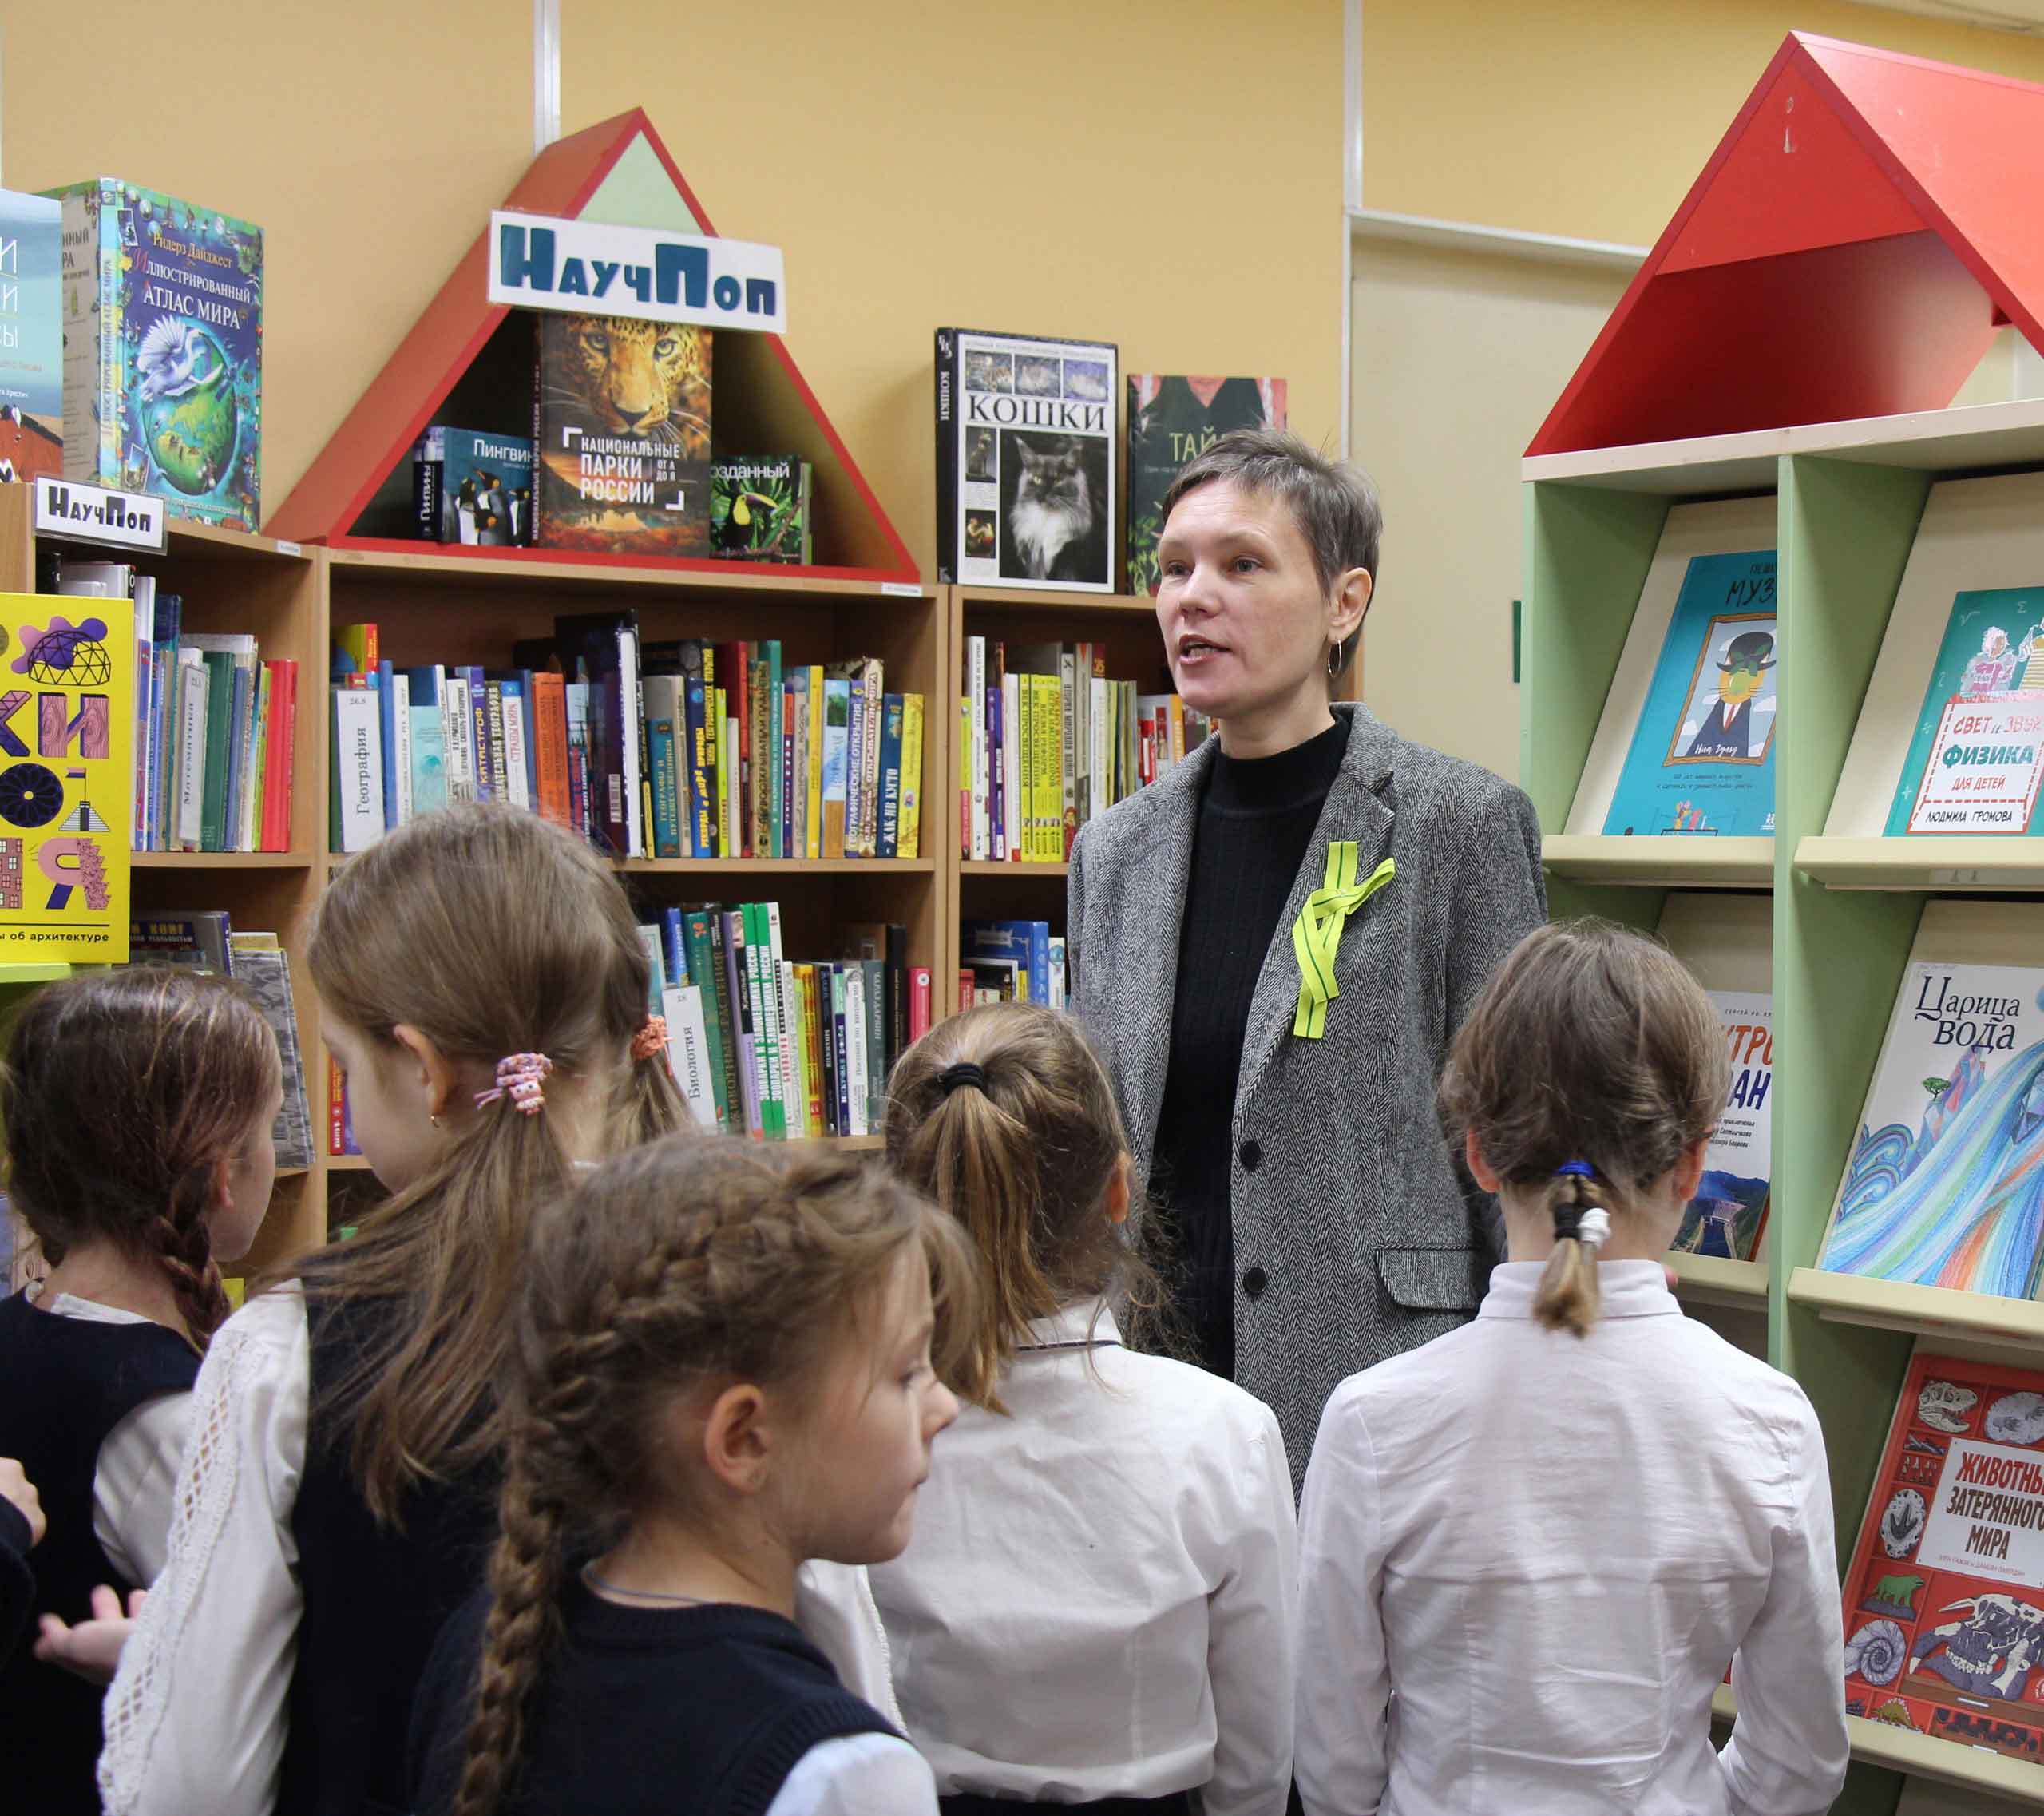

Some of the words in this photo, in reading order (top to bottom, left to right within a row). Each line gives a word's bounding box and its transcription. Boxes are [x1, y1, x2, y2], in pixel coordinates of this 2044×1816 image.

[153, 232, 187, 255] Ридерз
[188, 242, 233, 268] Дайджест
[134, 248, 251, 303] ИЛЛЮСТРИРОВАННЫЙ
[143, 284, 195, 316] АТЛАС
[197, 299, 241, 329] МИРА
[940, 371, 950, 421] КОШКИ
[968, 395, 1107, 431] КОШКИ
[581, 437, 679, 458] НАЦИОНАЛЬНЫЕ
[1169, 426, 1227, 462] ТАЙ
[581, 453, 642, 478] ПАРКИ
[656, 470, 667, 482] ДО
[657, 459, 667, 470] ОТ
[670, 460, 675, 470] А
[421, 465, 431, 521] Пингвины
[581, 477, 655, 505] РОССИИ
[488, 688, 503, 736] ГЕОГРАФИЯ
[851, 703, 862, 757] ОТКРЫТИЯ
[1954, 716, 1992, 734] СВЕТ
[475, 708, 488, 783] КАТАСТРОФ
[510, 728, 521, 762] СТРАНЫ
[695, 728, 705, 767] ПРИРОДЫ
[1943, 744, 2034, 768] ФИЗИКА
[356, 728, 371, 815] География
[666, 740, 678, 835] ПУТЕШЕСТВЕННИКИ
[1951, 777, 1972, 791] ДЛЯ
[1974, 775, 2006, 791] ДЕТЕЙ
[658, 771, 667, 822] ГЕОГРАФЫ
[847, 759, 862, 849] ГЕОГРАФИЧЕСКИЕ
[699, 810, 709, 848] РЕКОРДЫ
[1926, 811, 1967, 823] ЛЮДМИЛА
[1972, 811, 2013, 823] ГРОМОВА
[10, 931, 25, 940] об
[30, 933, 109, 944] архитектуре
[745, 945, 759, 979] РОССИИ
[758, 945, 771, 979] РОССИИ
[739, 969, 750, 1010] Животные
[1915, 976, 2020, 1022] Царица
[748, 983, 765, 1044] ЗАПОВЕДНИКИ
[763, 983, 777, 1044] ЗАПОВЕДНИКИ
[684, 1025, 701, 1100] Биология
[755, 1057, 768, 1100] ЗООПАРКИ
[768, 1057, 782, 1100] ЗООПАРКИ
[1727, 1069, 1771, 1109] АН
[1947, 1486, 2044, 1531] ЗАТЕРЯННОГО
[1966, 1525, 2010, 1560] МИРА
